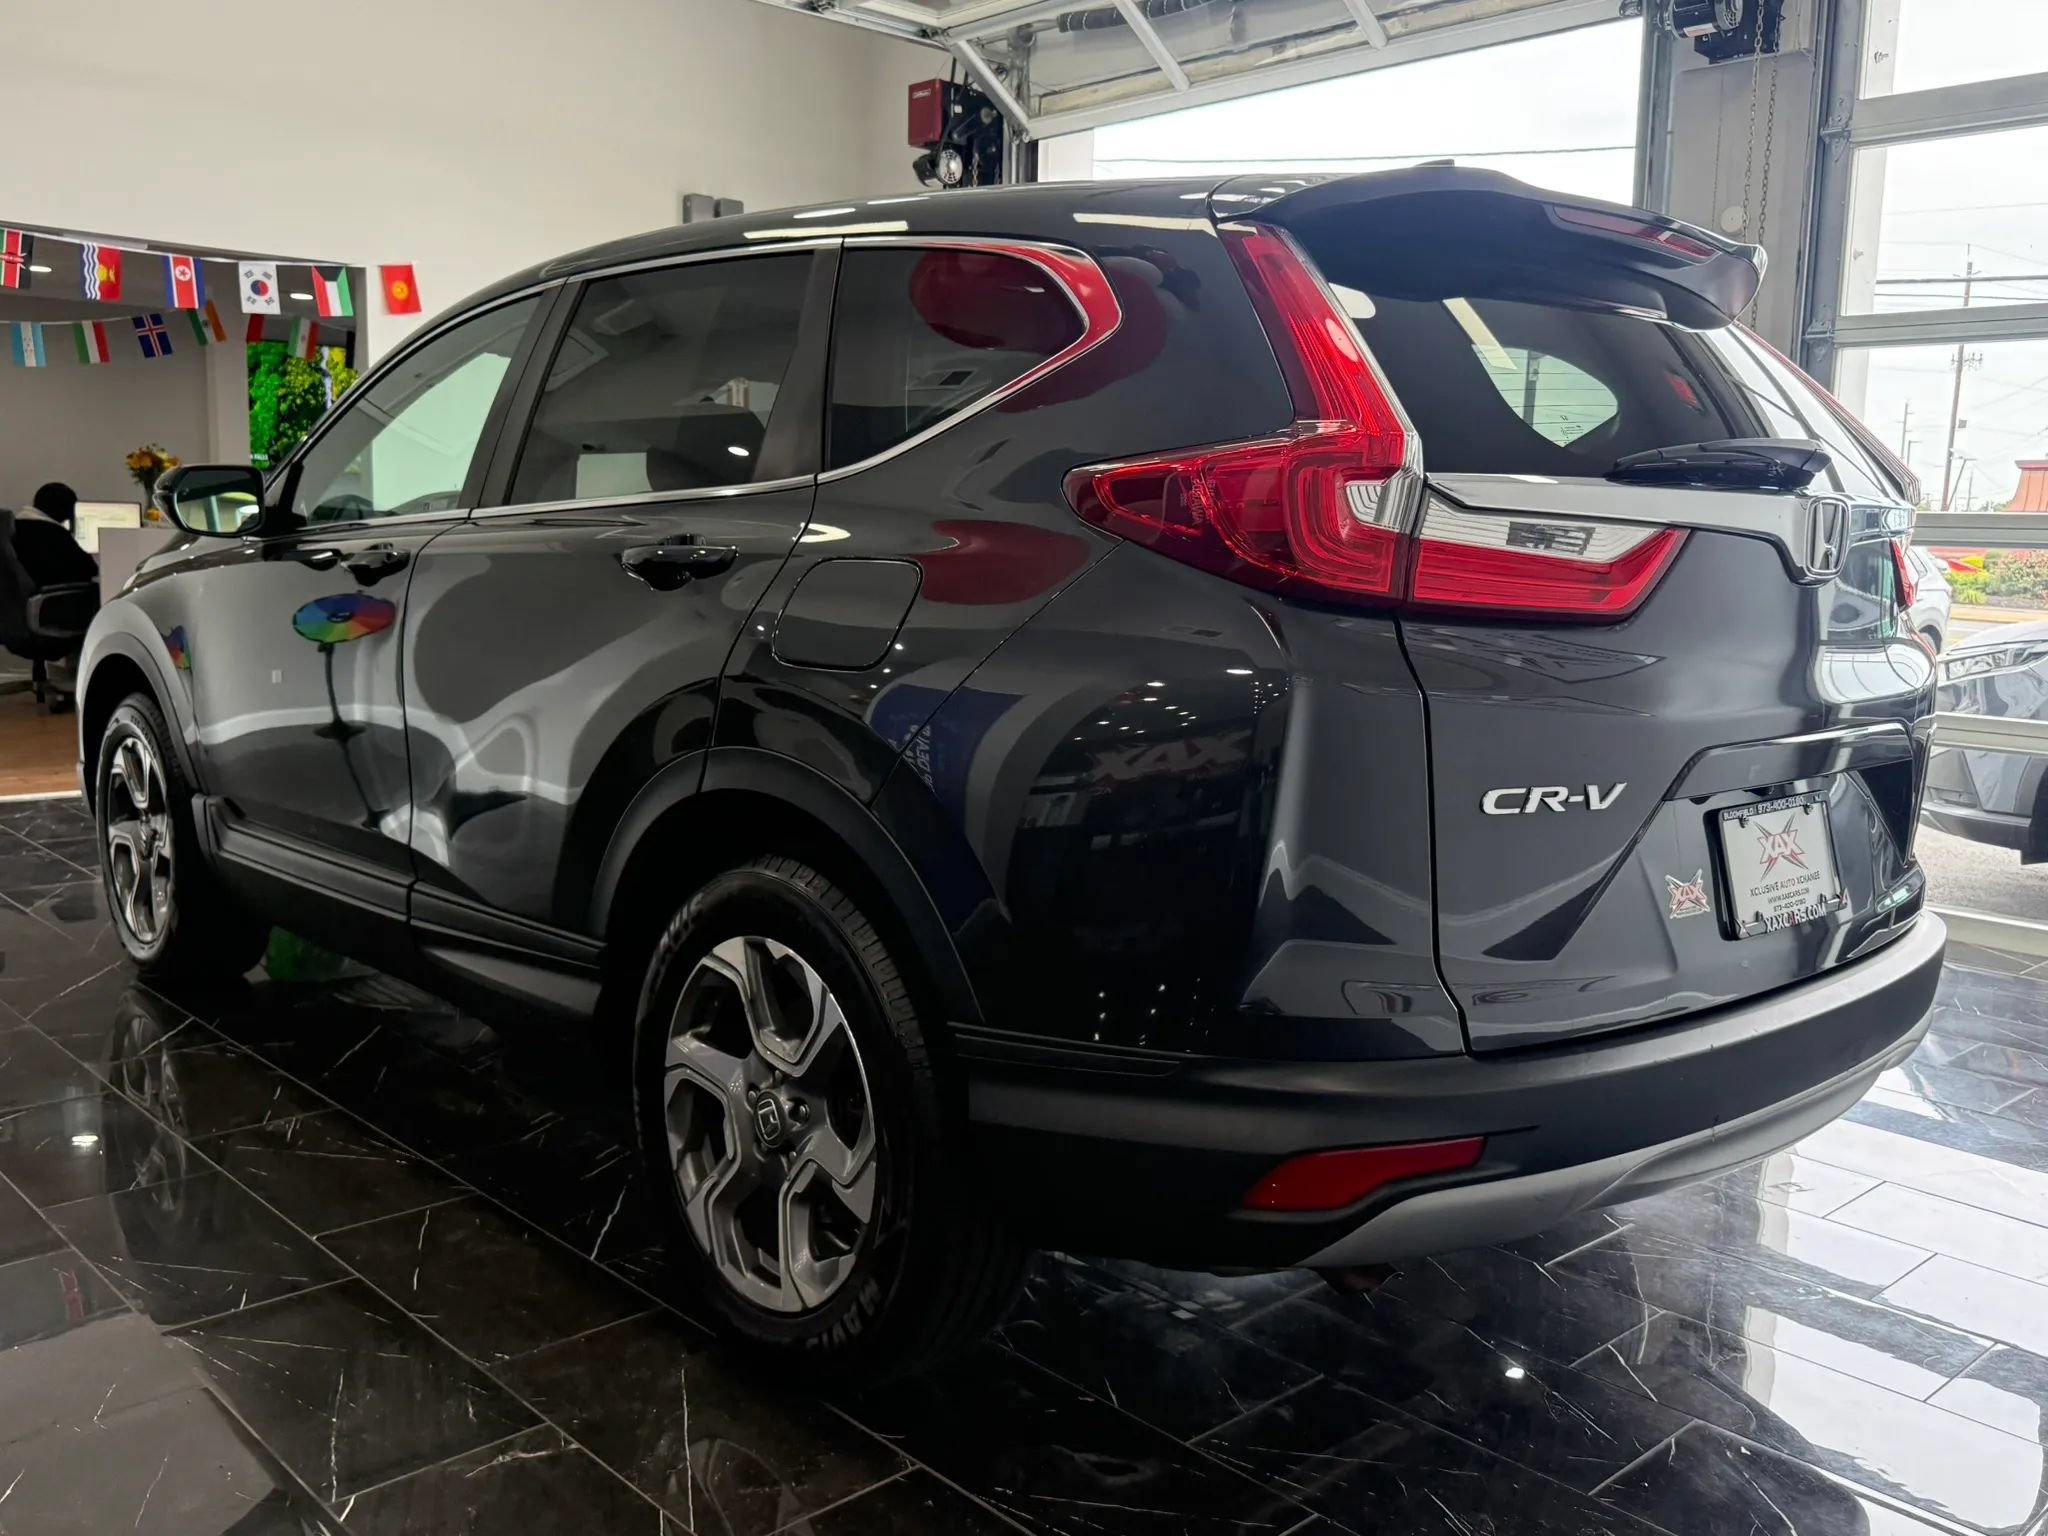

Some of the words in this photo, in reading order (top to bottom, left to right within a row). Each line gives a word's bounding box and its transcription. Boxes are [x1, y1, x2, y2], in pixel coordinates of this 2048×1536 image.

[1480, 782, 1627, 815] CR-V
[1750, 881, 1779, 897] XCLUSIVE
[1780, 877, 1796, 889] AUTO
[1764, 902, 1827, 933] XAXCARS.COM
